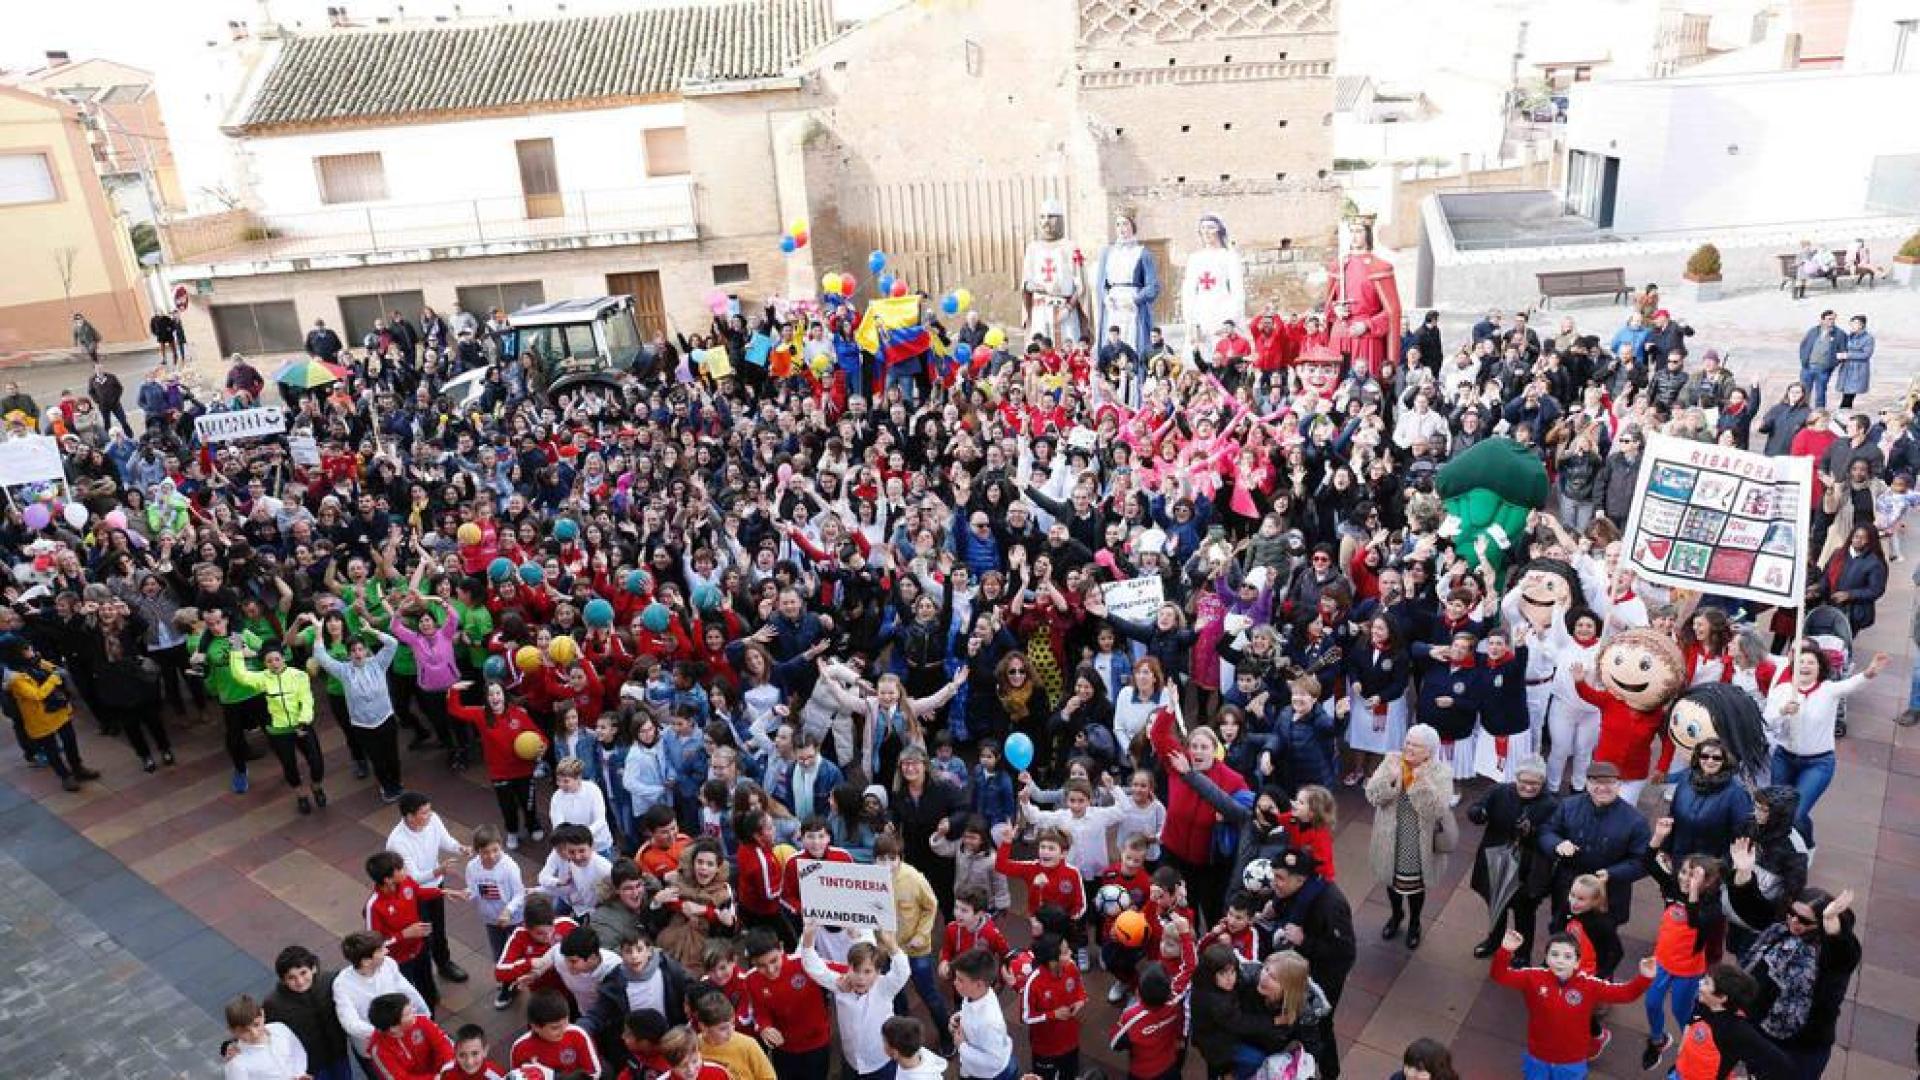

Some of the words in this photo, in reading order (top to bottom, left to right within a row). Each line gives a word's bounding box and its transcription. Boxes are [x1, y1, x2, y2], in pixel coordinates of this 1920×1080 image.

[1690, 450, 1776, 480] RIBAFORA
[818, 876, 889, 892] TINTORERIA
[804, 908, 878, 923] LAVANDERIA
